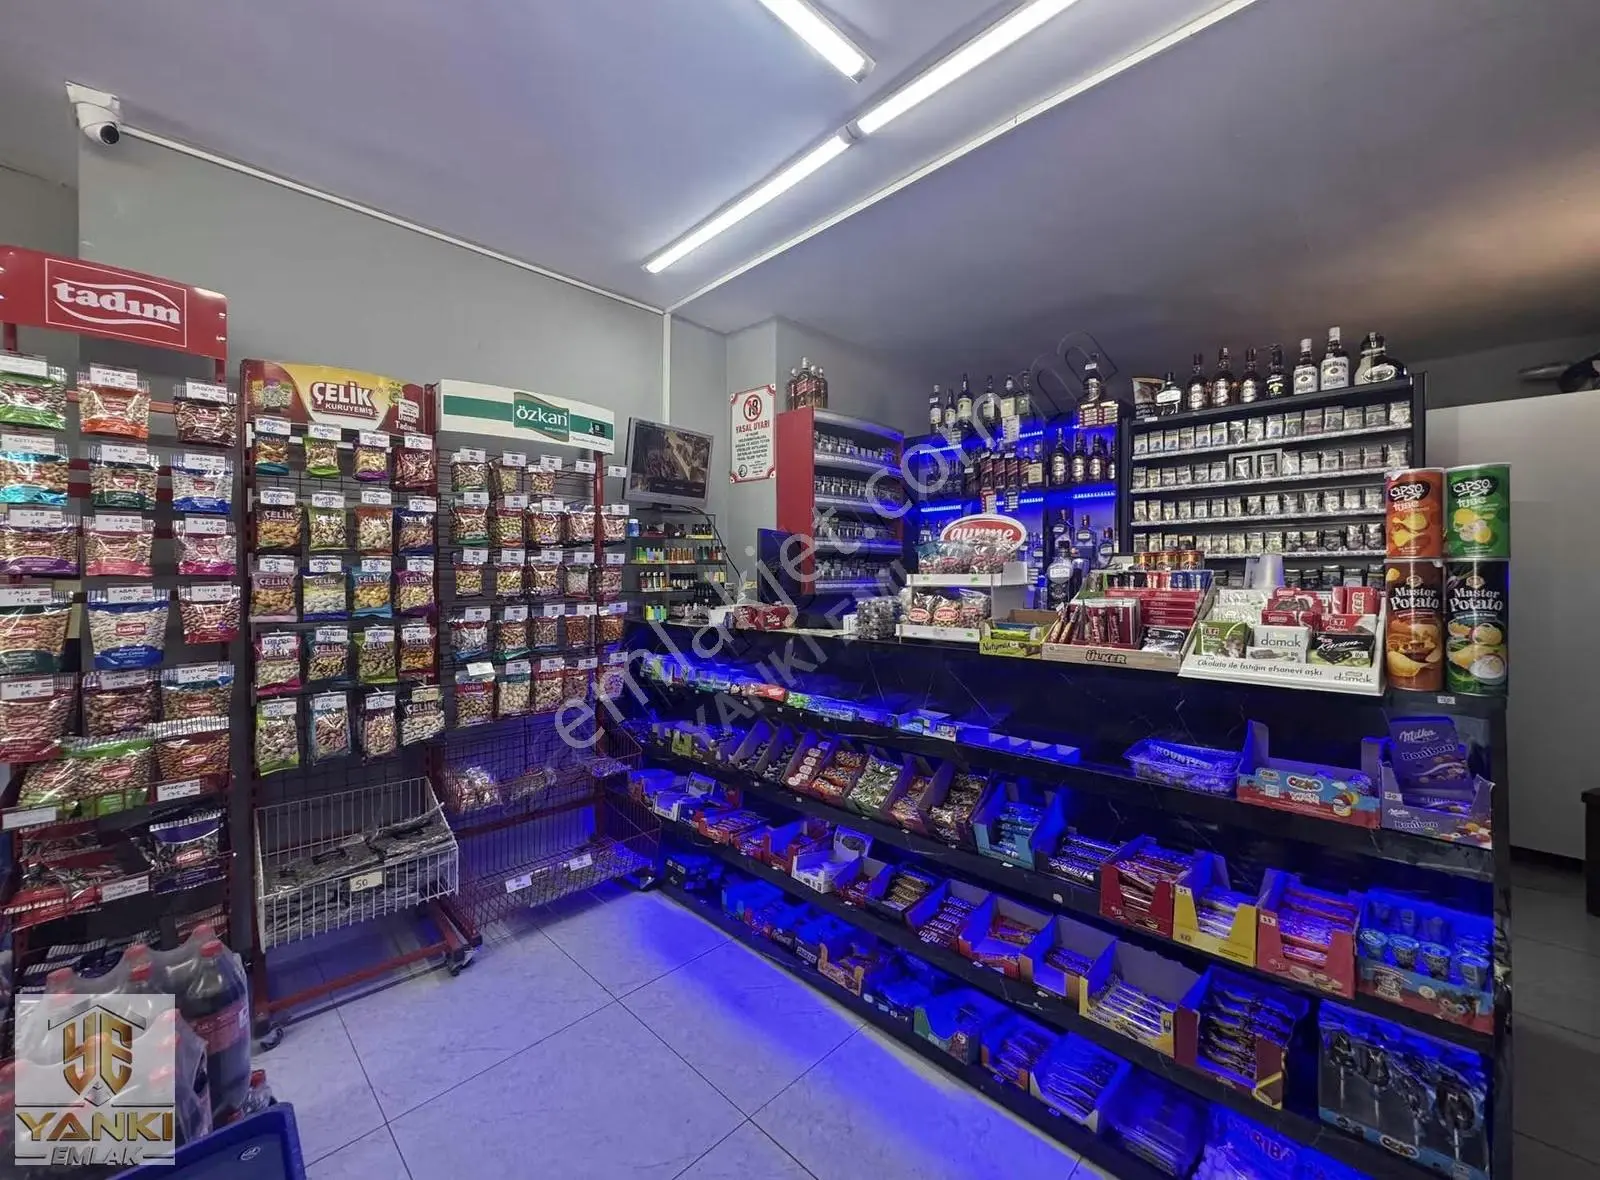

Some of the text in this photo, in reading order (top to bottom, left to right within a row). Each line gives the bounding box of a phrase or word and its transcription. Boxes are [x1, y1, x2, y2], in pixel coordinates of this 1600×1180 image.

[53, 281, 181, 324] tadım
[312, 381, 373, 406] ÇELİK
[325, 402, 374, 416] KURUYEMİŞ
[516, 405, 567, 426] özkan
[736, 420, 770, 434] YASAL UYARI
[1395, 587, 1437, 597] Master
[1454, 587, 1500, 599] Master
[1390, 596, 1440, 610] Potato
[1449, 597, 1504, 613] Potato
[1261, 632, 1301, 648] damak
[1085, 650, 1127, 665] ÜLKER
[1333, 672, 1374, 684] damak
[1400, 728, 1438, 742] Milka
[355, 879, 369, 889] 50
